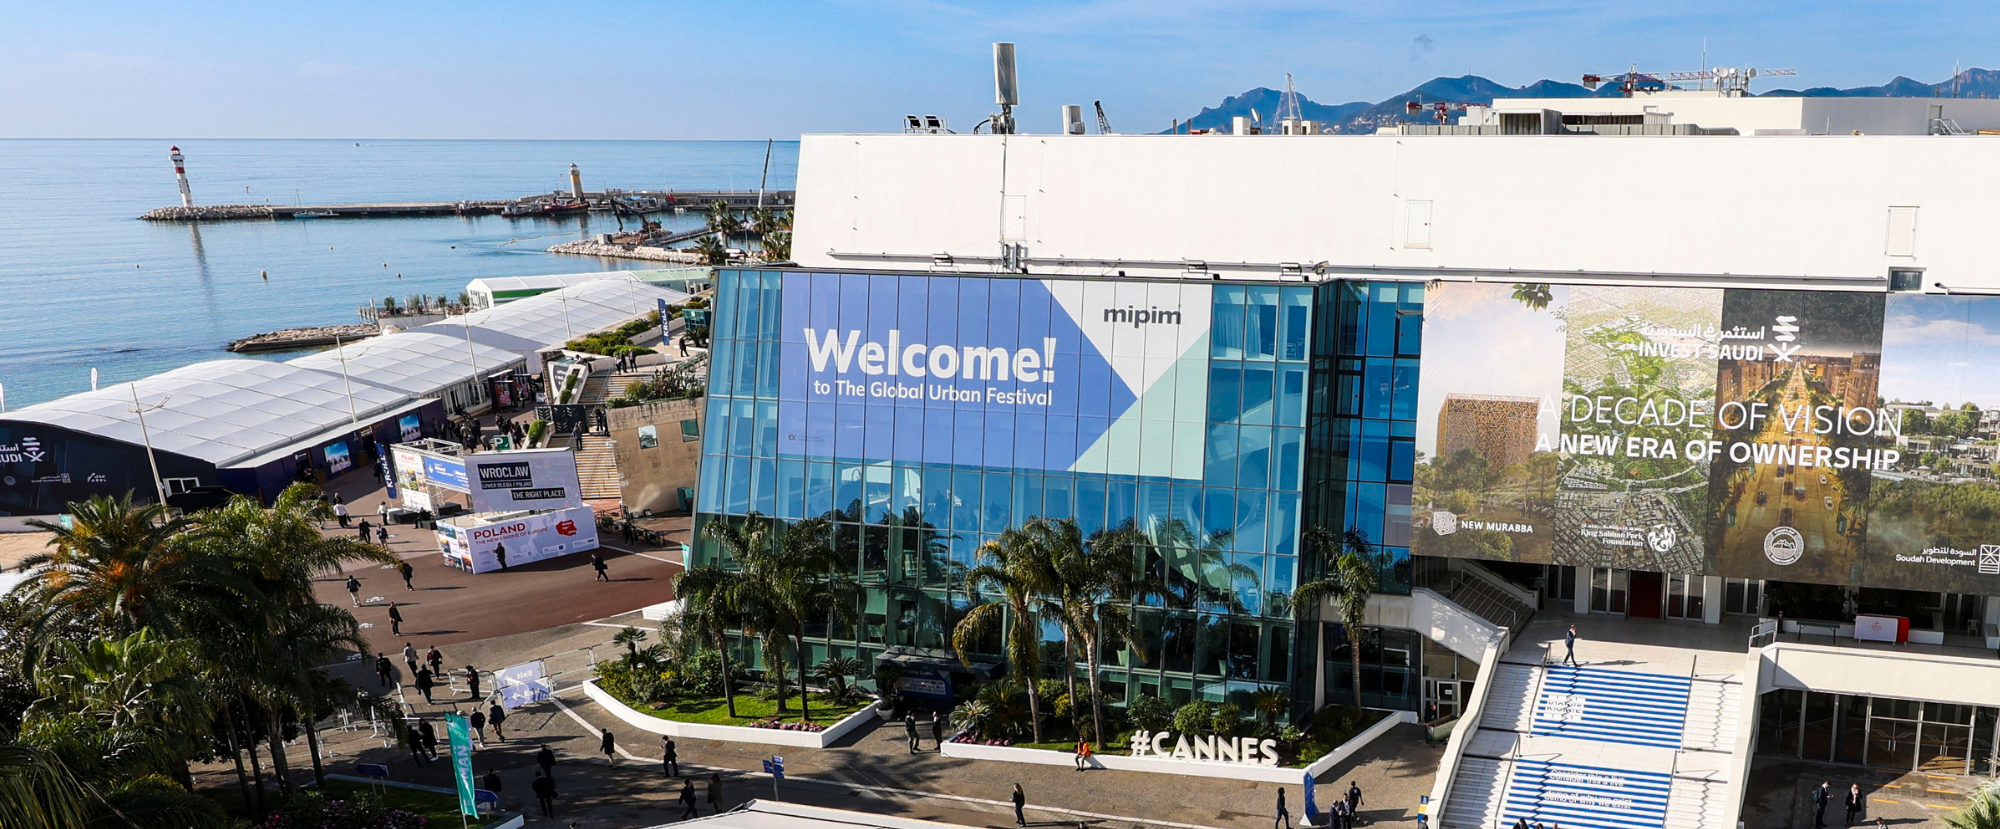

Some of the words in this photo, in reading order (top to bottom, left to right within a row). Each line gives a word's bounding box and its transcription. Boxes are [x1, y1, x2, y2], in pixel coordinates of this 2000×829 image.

[661, 309, 669, 337] KROLL
[1103, 305, 1182, 328] mipim
[1717, 325, 1765, 341] استثمر
[803, 327, 1057, 383] Welcome!
[1638, 341, 1701, 359] INVEST
[1708, 343, 1764, 361] SAUDI
[814, 380, 830, 395] to
[835, 380, 865, 397] The
[870, 381, 923, 400] Global
[929, 384, 981, 404] Urban
[987, 387, 1053, 406] Festival
[1536, 394, 1559, 421] A
[1570, 394, 1708, 428] DECADE
[1718, 401, 1768, 431] OF
[1778, 403, 1903, 437] VISION
[494, 437, 503, 447] P
[1535, 432, 1552, 453] A
[1560, 433, 1617, 457] NEW
[1625, 436, 1677, 460] ERA
[1685, 439, 1722, 462] OF
[1729, 440, 1901, 471] OWNERSHIP
[381, 454, 393, 488] KROLL
[480, 465, 529, 479] WROCLAW
[525, 490, 542, 498] RIGHT
[543, 489, 564, 498] PLACE!
[473, 523, 526, 540] POLAND
[487, 537, 499, 545] NEW
[500, 533, 519, 543] ENGINE
[527, 527, 549, 536] EUROPE
[1461, 520, 1484, 530] NEW
[1486, 521, 1534, 534] MURABBA
[1581, 528, 1598, 537] King
[1599, 530, 1625, 539] Salman
[1626, 532, 1645, 541] Park
[1602, 537, 1643, 547] Foundation
[1895, 553, 1924, 563] Soudah
[1926, 556, 1976, 568] Development
[523, 687, 540, 697] Exit
[1130, 730, 1280, 767] #CANNES
[1549, 769, 1585, 783] Consider
[1587, 772, 1603, 784] this
[1610, 775, 1626, 787] live
[1544, 790, 1567, 803] demo
[1568, 792, 1579, 804] of
[1579, 793, 1598, 806] why
[1599, 796, 1612, 807] we
[1612, 797, 1632, 809] exist
